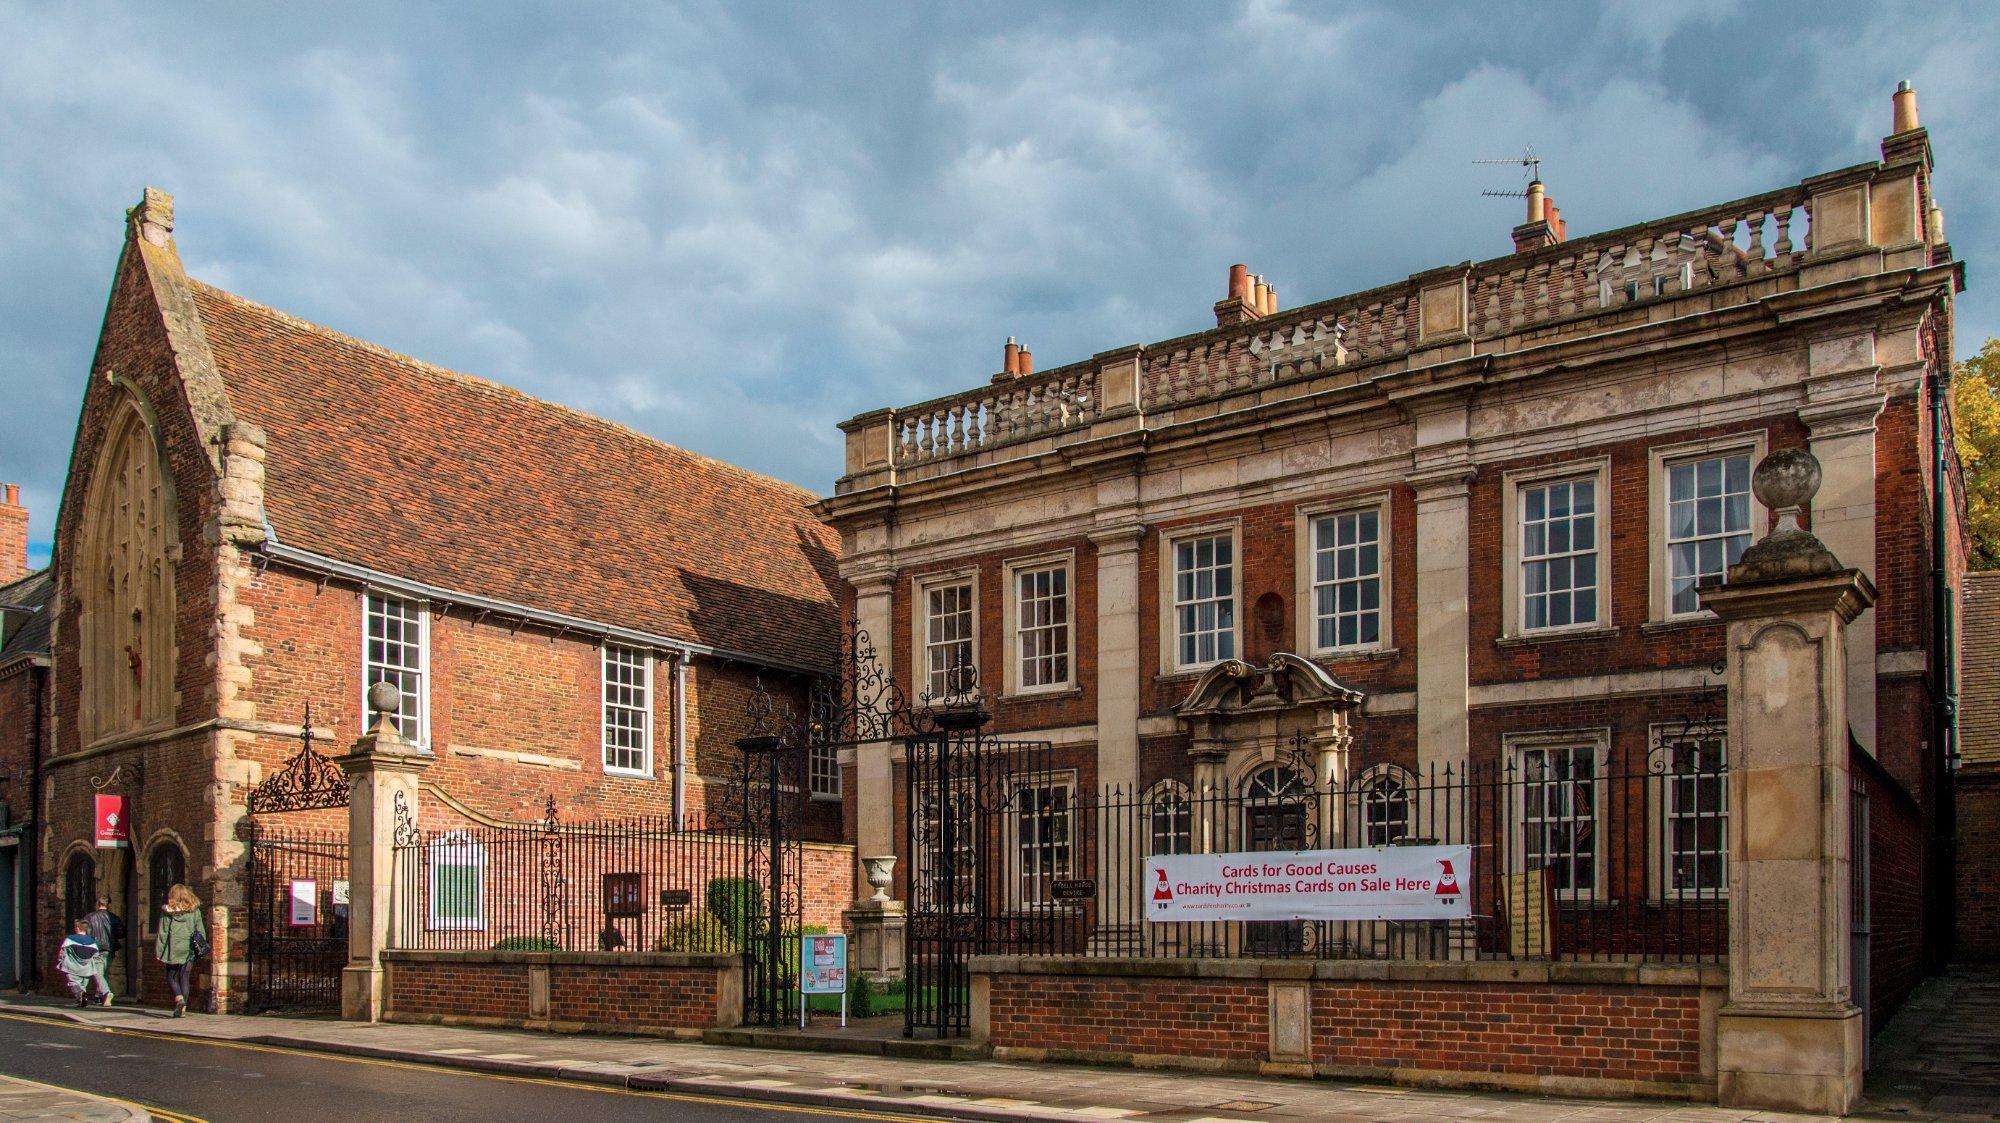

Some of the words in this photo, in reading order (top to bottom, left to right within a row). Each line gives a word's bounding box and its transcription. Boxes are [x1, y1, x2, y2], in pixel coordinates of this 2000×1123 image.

[1222, 864, 1259, 878] Cards
[1262, 864, 1281, 876] for
[1285, 862, 1323, 877] Good
[1327, 862, 1377, 875] Causes
[1176, 883, 1222, 897] Charity
[1225, 882, 1291, 894] Christmas
[1295, 879, 1334, 893] Cards
[1338, 881, 1356, 892] on
[1360, 878, 1391, 892] Sale
[1395, 878, 1431, 891] Here
